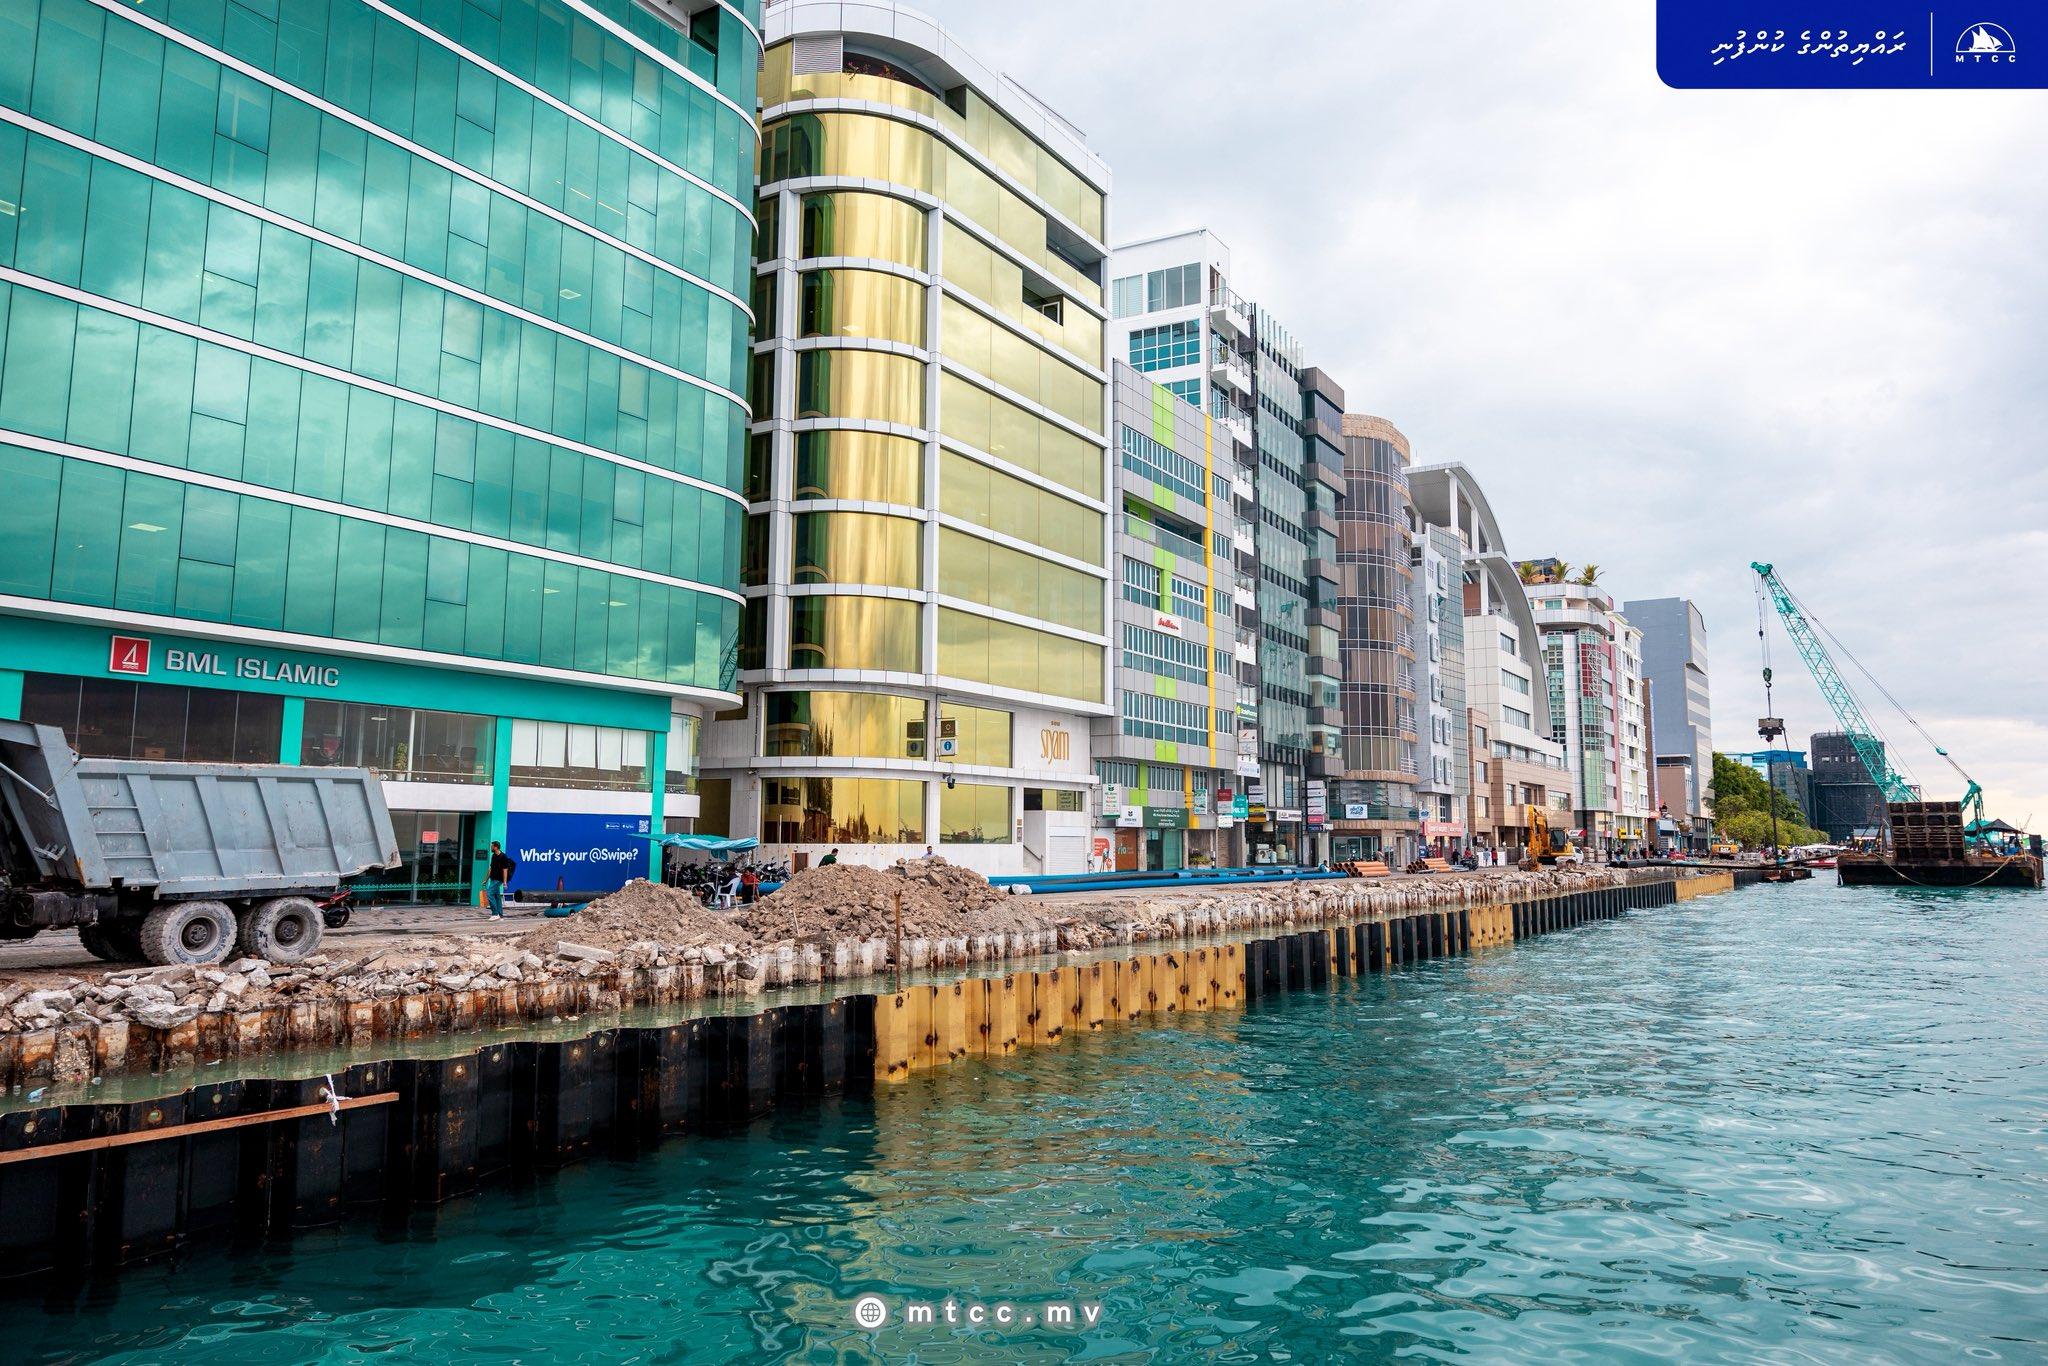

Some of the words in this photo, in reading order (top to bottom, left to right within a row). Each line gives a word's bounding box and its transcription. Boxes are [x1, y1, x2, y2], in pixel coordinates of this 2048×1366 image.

[165, 649, 227, 677] BML
[235, 656, 341, 688] ISLAMIC
[519, 848, 561, 862] What's
[562, 851, 588, 865] your
[589, 847, 639, 864] @Swipe?
